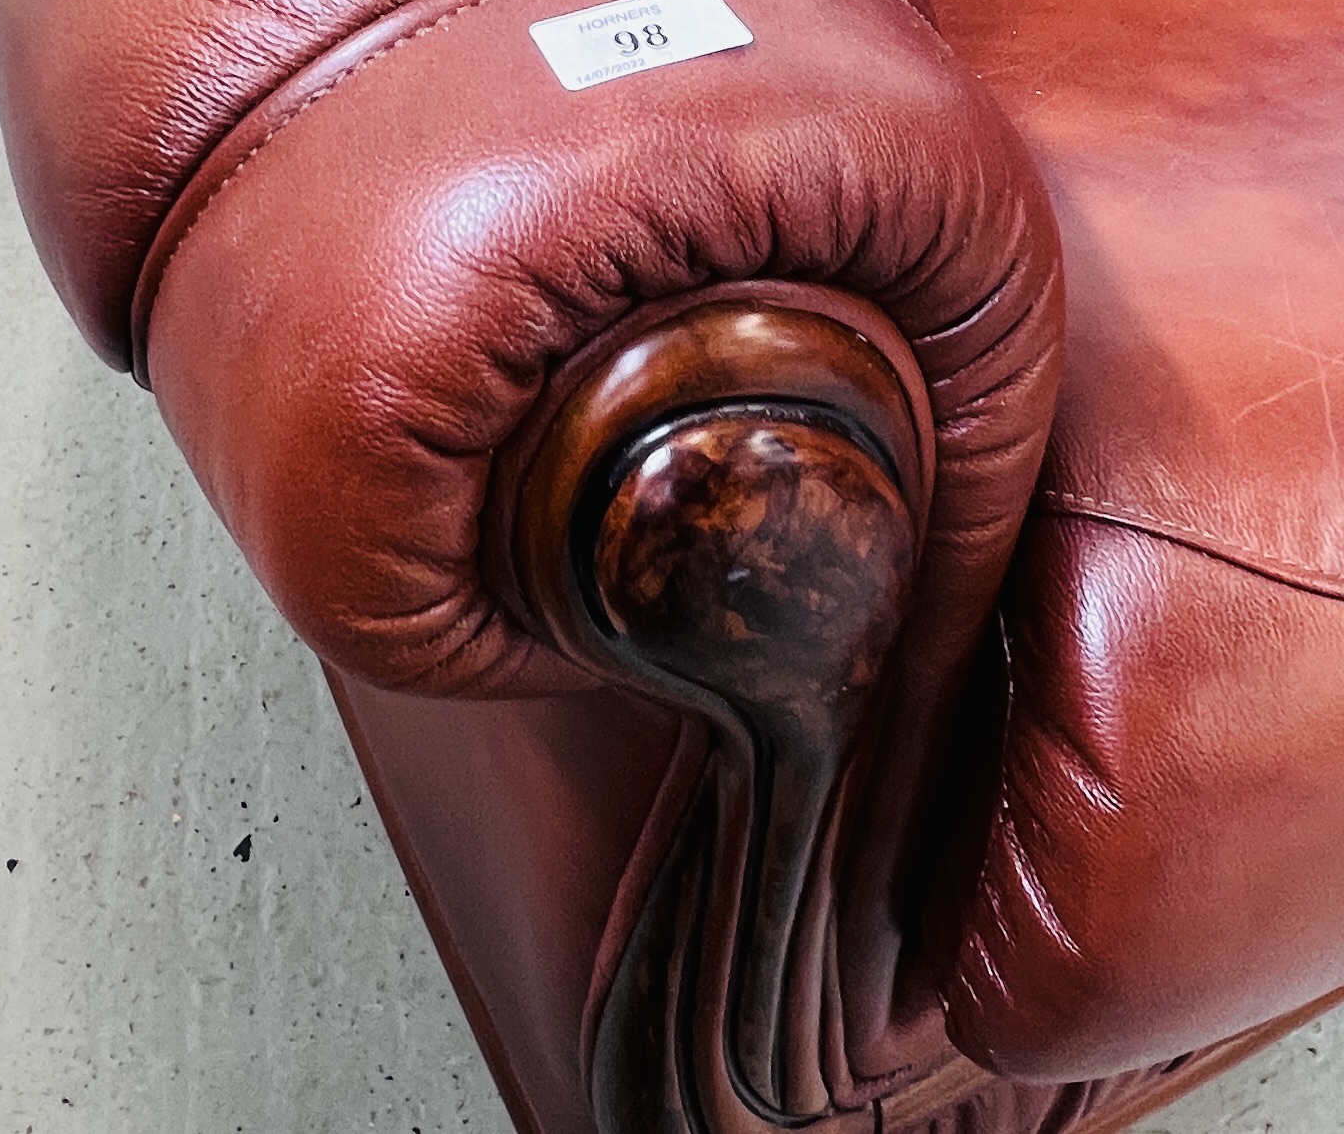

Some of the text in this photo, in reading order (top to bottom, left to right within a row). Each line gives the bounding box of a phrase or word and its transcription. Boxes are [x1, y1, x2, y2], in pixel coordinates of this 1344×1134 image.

[578, 4, 662, 34] HORNERS
[614, 23, 669, 55] 98
[577, 58, 646, 84] 14/07/2022
